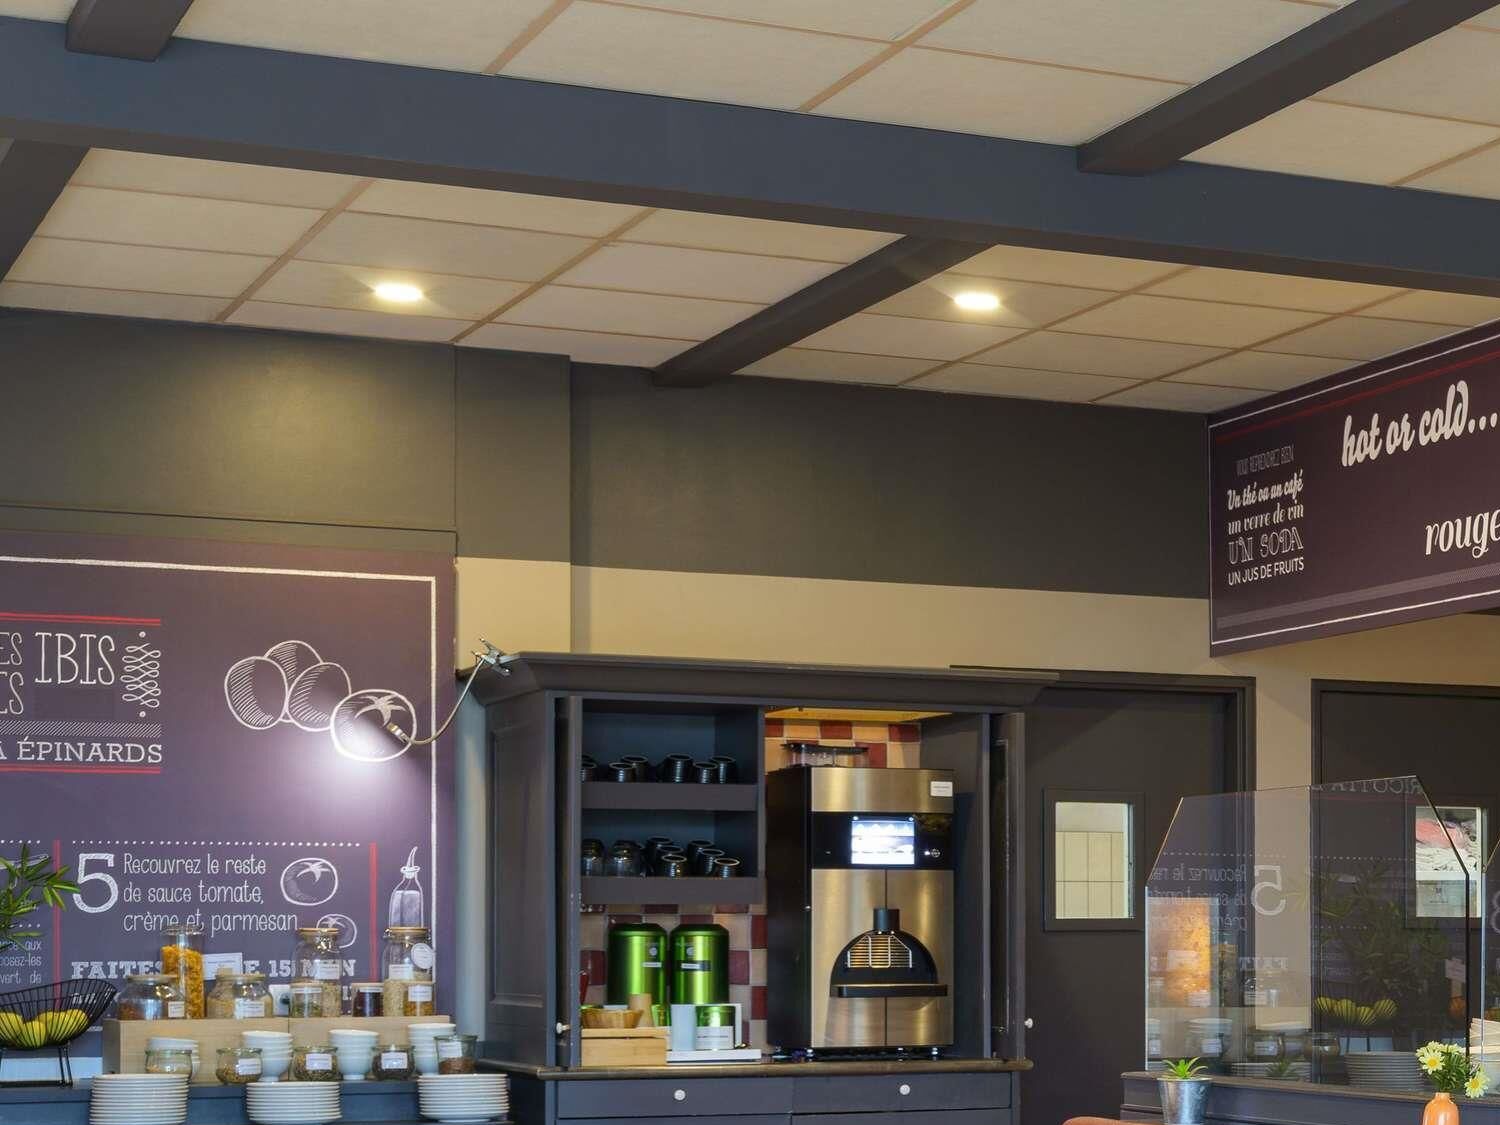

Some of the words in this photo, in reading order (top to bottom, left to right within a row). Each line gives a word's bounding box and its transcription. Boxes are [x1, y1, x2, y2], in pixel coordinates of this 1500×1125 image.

[1341, 415, 1381, 467] hot
[1386, 420, 1415, 457] or
[1418, 379, 1499, 446] cold...
[1226, 489, 1242, 511] Un
[1242, 482, 1257, 506] thé
[1283, 468, 1304, 499] café
[1228, 519, 1242, 535] un
[1244, 511, 1271, 531] verre
[1272, 502, 1286, 525] de
[1287, 499, 1304, 520] vin
[1228, 536, 1254, 565] UN
[1260, 526, 1304, 558] SODA
[1228, 570, 1241, 586] UN
[1242, 566, 1259, 583] JUS
[1260, 563, 1272, 579] DE
[1273, 556, 1305, 577] FRUITS
[34, 631, 116, 685] IBIS
[16, 735, 163, 763] ÉPINARDS
[123, 853, 201, 875] Recouvrez
[207, 853, 218, 874] le
[225, 858, 266, 874] reste
[72, 853, 119, 913] 5
[123, 881, 141, 902] de
[147, 885, 192, 903] sauce
[198, 880, 264, 904] tomate,
[123, 911, 179, 931] crème
[186, 909, 204, 931] et
[211, 915, 298, 938] parmesan
